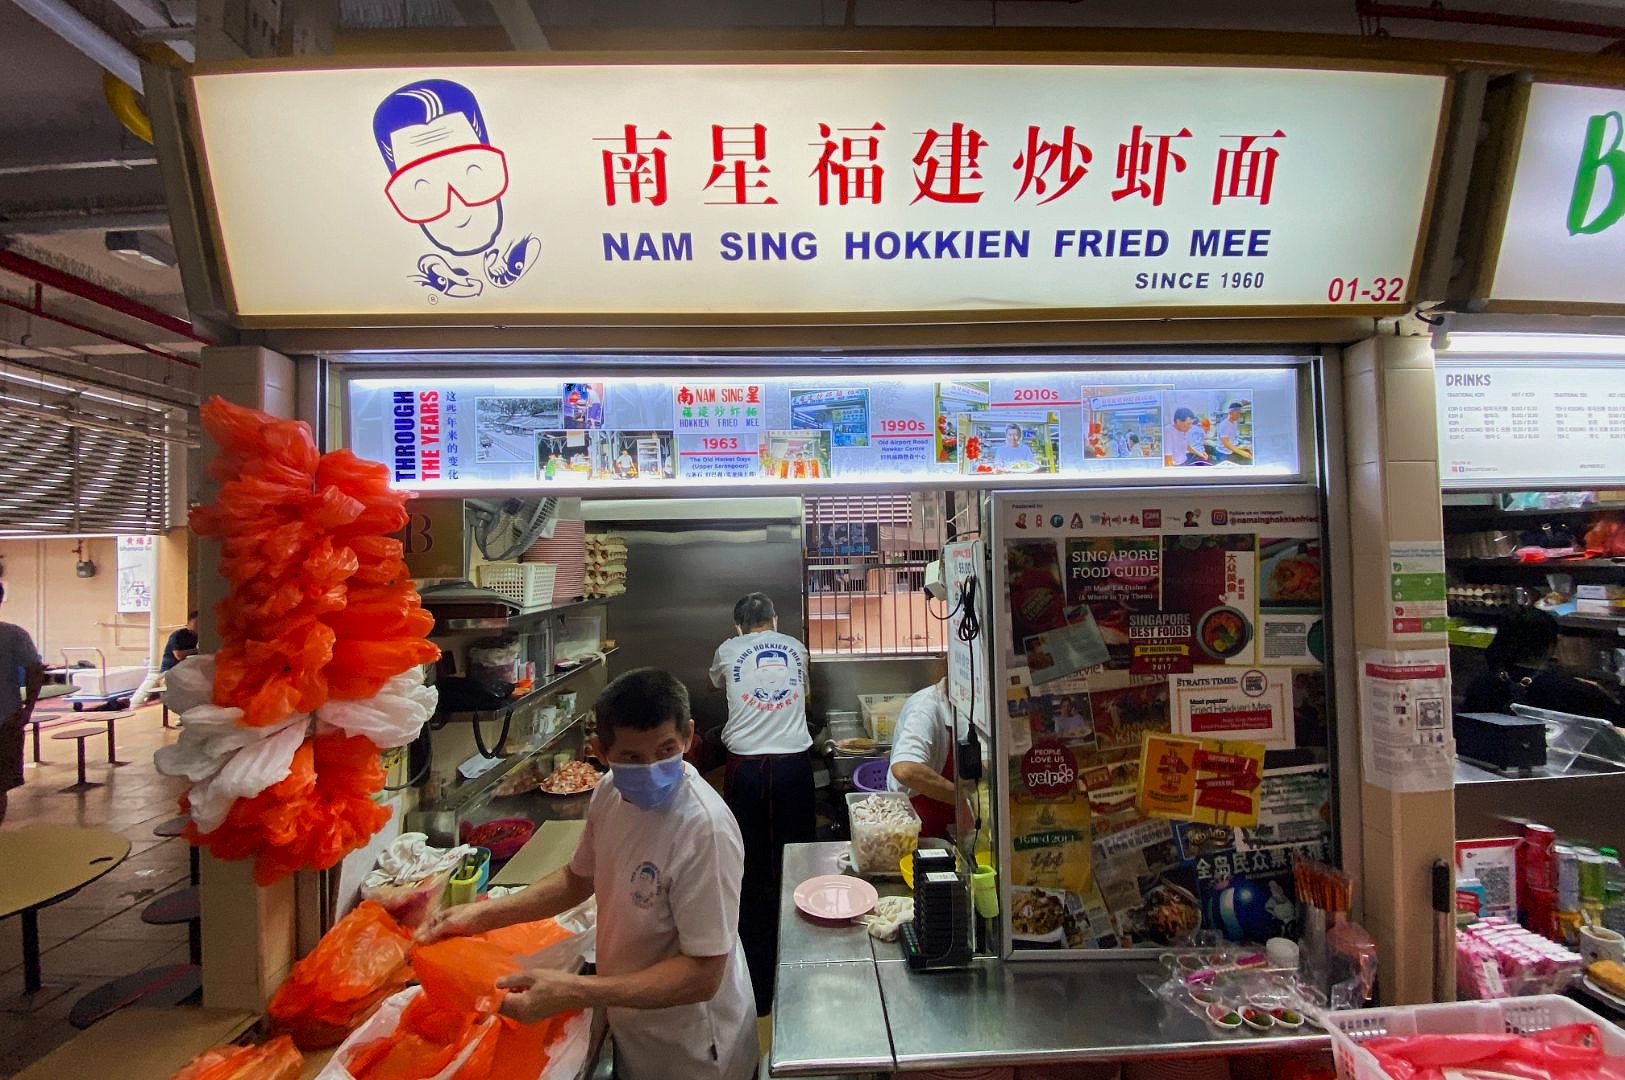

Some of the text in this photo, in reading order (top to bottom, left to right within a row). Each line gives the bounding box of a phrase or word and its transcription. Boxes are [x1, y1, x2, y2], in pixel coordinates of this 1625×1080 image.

[591, 121, 1287, 207] 南星福建炒虾面
[602, 229, 1271, 261] NAM SING HOKKIEN FRIED MEE
[1135, 271, 1265, 290] SINCE 1960
[1328, 277, 1404, 302] 01-32
[1445, 374, 1491, 387] DRINKS
[695, 388, 744, 403] NAM SING
[1013, 388, 1059, 401] 2010s
[679, 418, 760, 428] HOKKIEN FRIED MEE
[880, 420, 926, 433] 1990s
[393, 391, 416, 483] THROUGH
[419, 390, 441, 481] THE YEARS
[446, 391, 459, 480] 这些年来的变化
[703, 437, 738, 449] 1963
[1071, 549, 1158, 563] SINGAPORE
[1072, 565, 1159, 579] FOOD GUIDE
[1129, 613, 1191, 627] SINGAPORE
[1130, 626, 1190, 638] BEST FOODS
[753, 642, 789, 652] HOKKIEN
[737, 648, 754, 664] SING
[788, 648, 802, 667] FRIED
[733, 664, 742, 682] NAM
[1152, 663, 1172, 671] 2017
[1027, 770, 1060, 787] yelp
